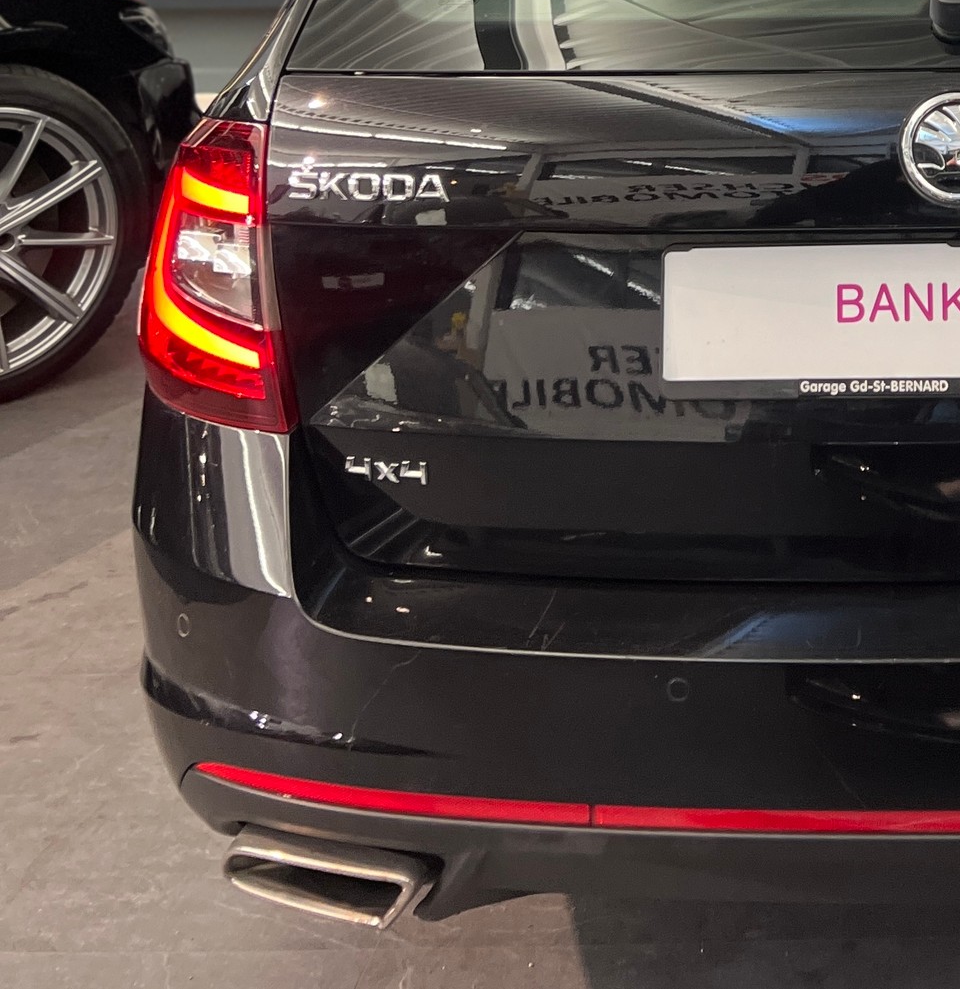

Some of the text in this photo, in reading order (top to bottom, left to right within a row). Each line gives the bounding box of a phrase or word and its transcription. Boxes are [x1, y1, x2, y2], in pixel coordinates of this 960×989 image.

[799, 378, 847, 394] Garage
[850, 378, 949, 394] Gd-St-BERNARD
[345, 455, 427, 486] 4x4
